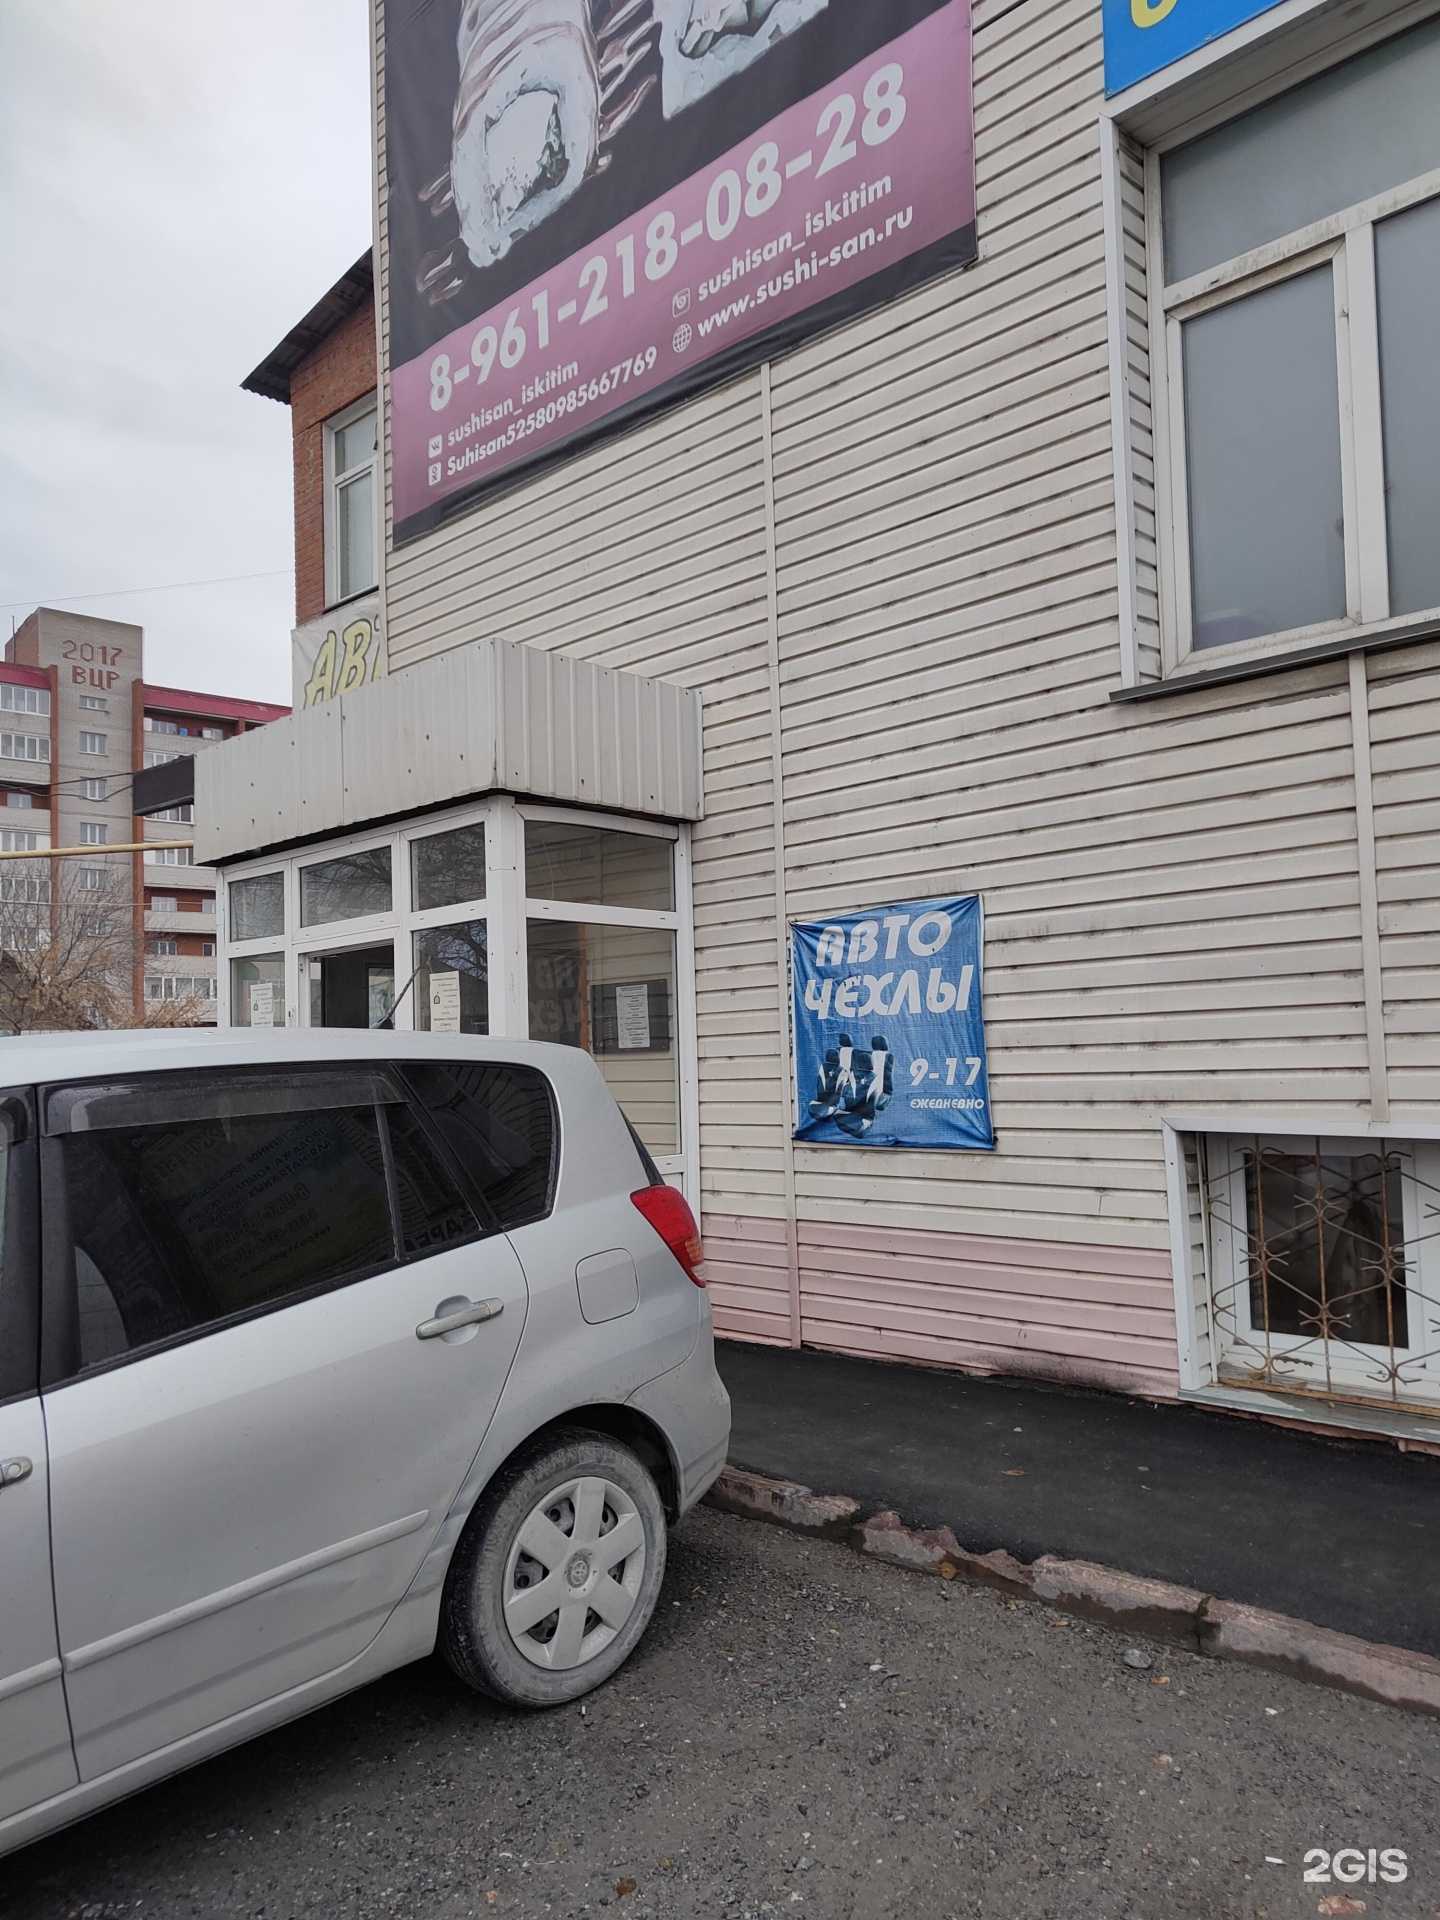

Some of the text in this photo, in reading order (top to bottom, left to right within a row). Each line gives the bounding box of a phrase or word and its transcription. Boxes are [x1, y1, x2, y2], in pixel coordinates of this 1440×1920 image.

[430, 63, 907, 412] 8-961-218-08-28
[697, 206, 913, 337] www.sushi-san.ru
[698, 175, 892, 301] sushisan_iskitim
[447, 361, 579, 446] sushisan_iskitim
[447, 346, 657, 476] Suhisan52580985667769
[62, 640, 123, 666] 2017
[303, 611, 382, 706] АВ
[816, 910, 953, 967] АВТО
[804, 965, 975, 1020] ЧЕХЛЫ
